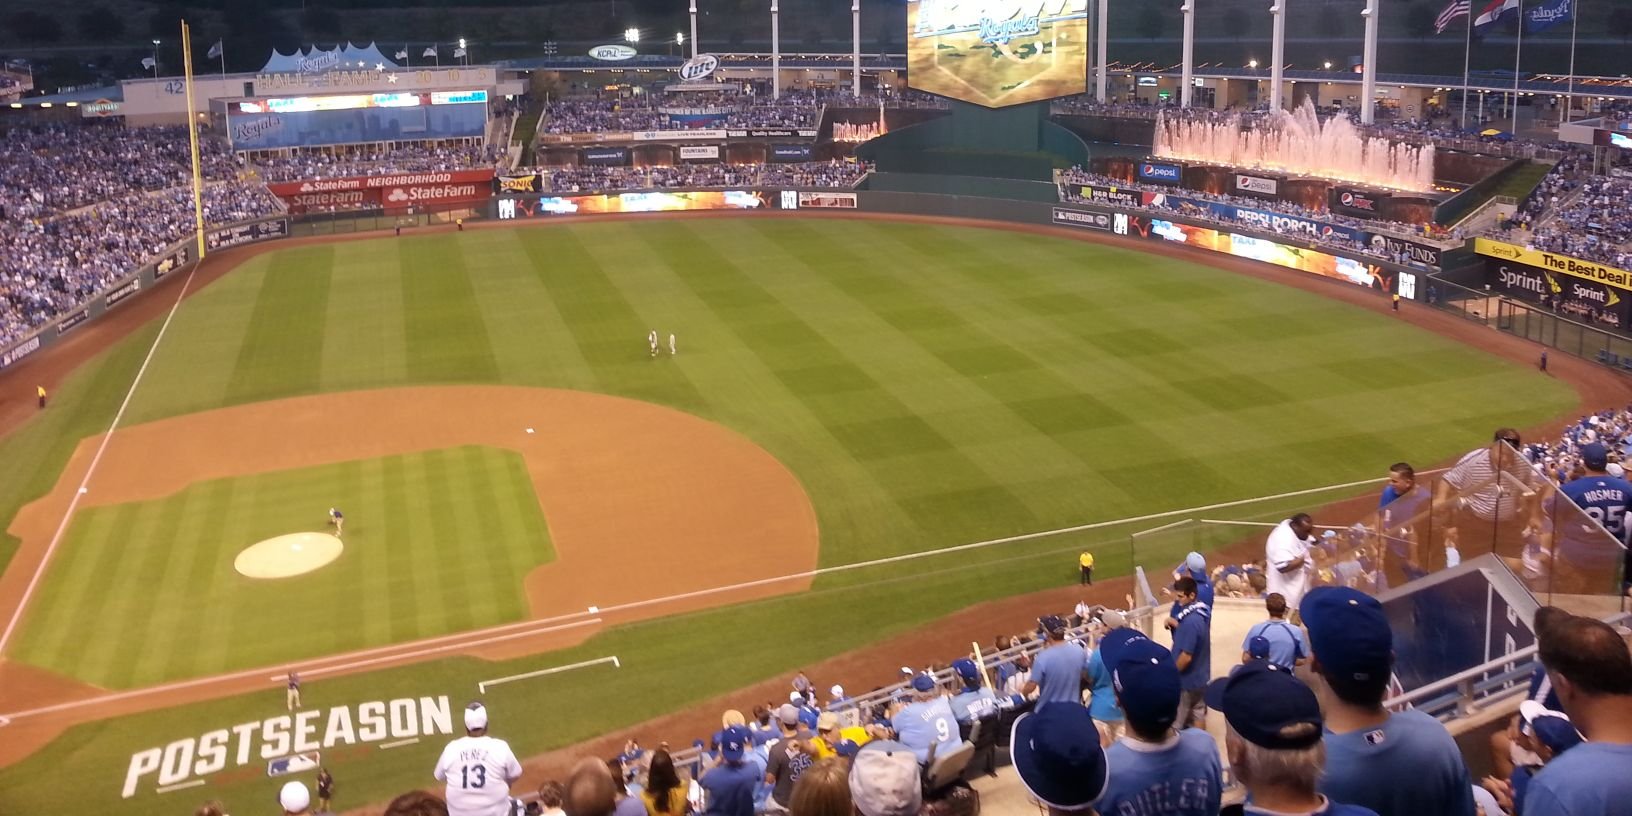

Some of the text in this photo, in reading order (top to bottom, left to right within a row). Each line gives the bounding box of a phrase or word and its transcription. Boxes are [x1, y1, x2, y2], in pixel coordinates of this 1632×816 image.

[978, 13, 1039, 44] Royals
[296, 51, 339, 75] Royals
[165, 81, 184, 94] 42
[256, 72, 305, 89] HALL
[233, 115, 280, 140] Royals
[367, 173, 451, 188] NEIGHBORHOOD
[1154, 167, 1176, 178] pepsi
[503, 180, 533, 189] SONIC
[1250, 180, 1273, 191] pepsi
[1108, 192, 1132, 200] BLOCK
[1236, 208, 1317, 236] PEPSI PORCH
[1491, 245, 1512, 259] Sprint
[1499, 265, 1543, 293] Sprint
[1542, 253, 1566, 270] The
[1567, 260, 1596, 278] Best
[1597, 267, 1627, 285] Deal
[1573, 282, 1605, 303] Sprint
[1583, 489, 1624, 503] HOSMER
[935, 717, 950, 742] 9
[121, 694, 454, 799] POSTSEASON
[460, 747, 489, 762] PEREZ
[461, 763, 487, 789] 13
[788, 752, 814, 782] 35
